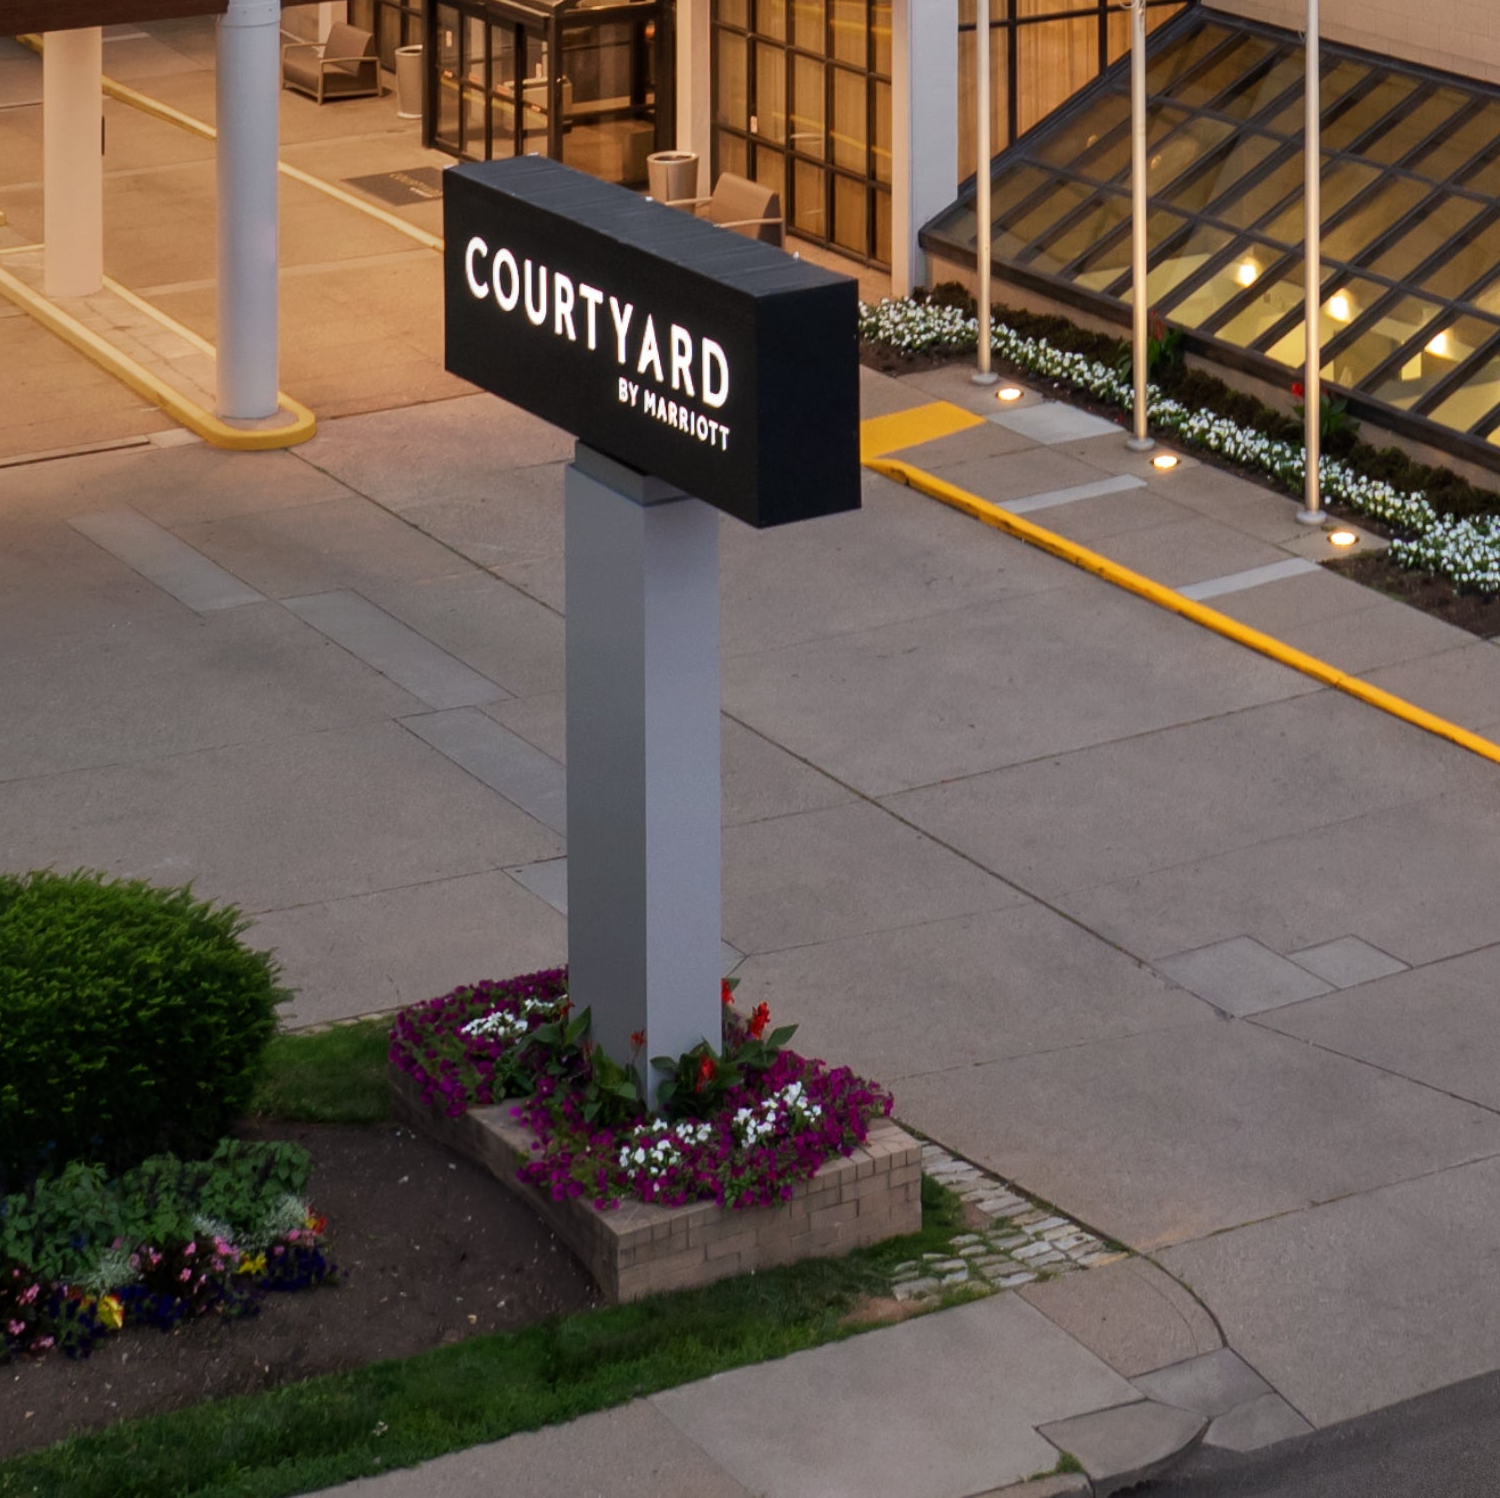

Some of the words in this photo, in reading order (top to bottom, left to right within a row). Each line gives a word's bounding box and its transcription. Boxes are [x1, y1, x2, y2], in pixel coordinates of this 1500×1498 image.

[465, 236, 729, 408] COURTYARD
[618, 376, 639, 407] BY
[643, 389, 730, 451] MARRIOTT
